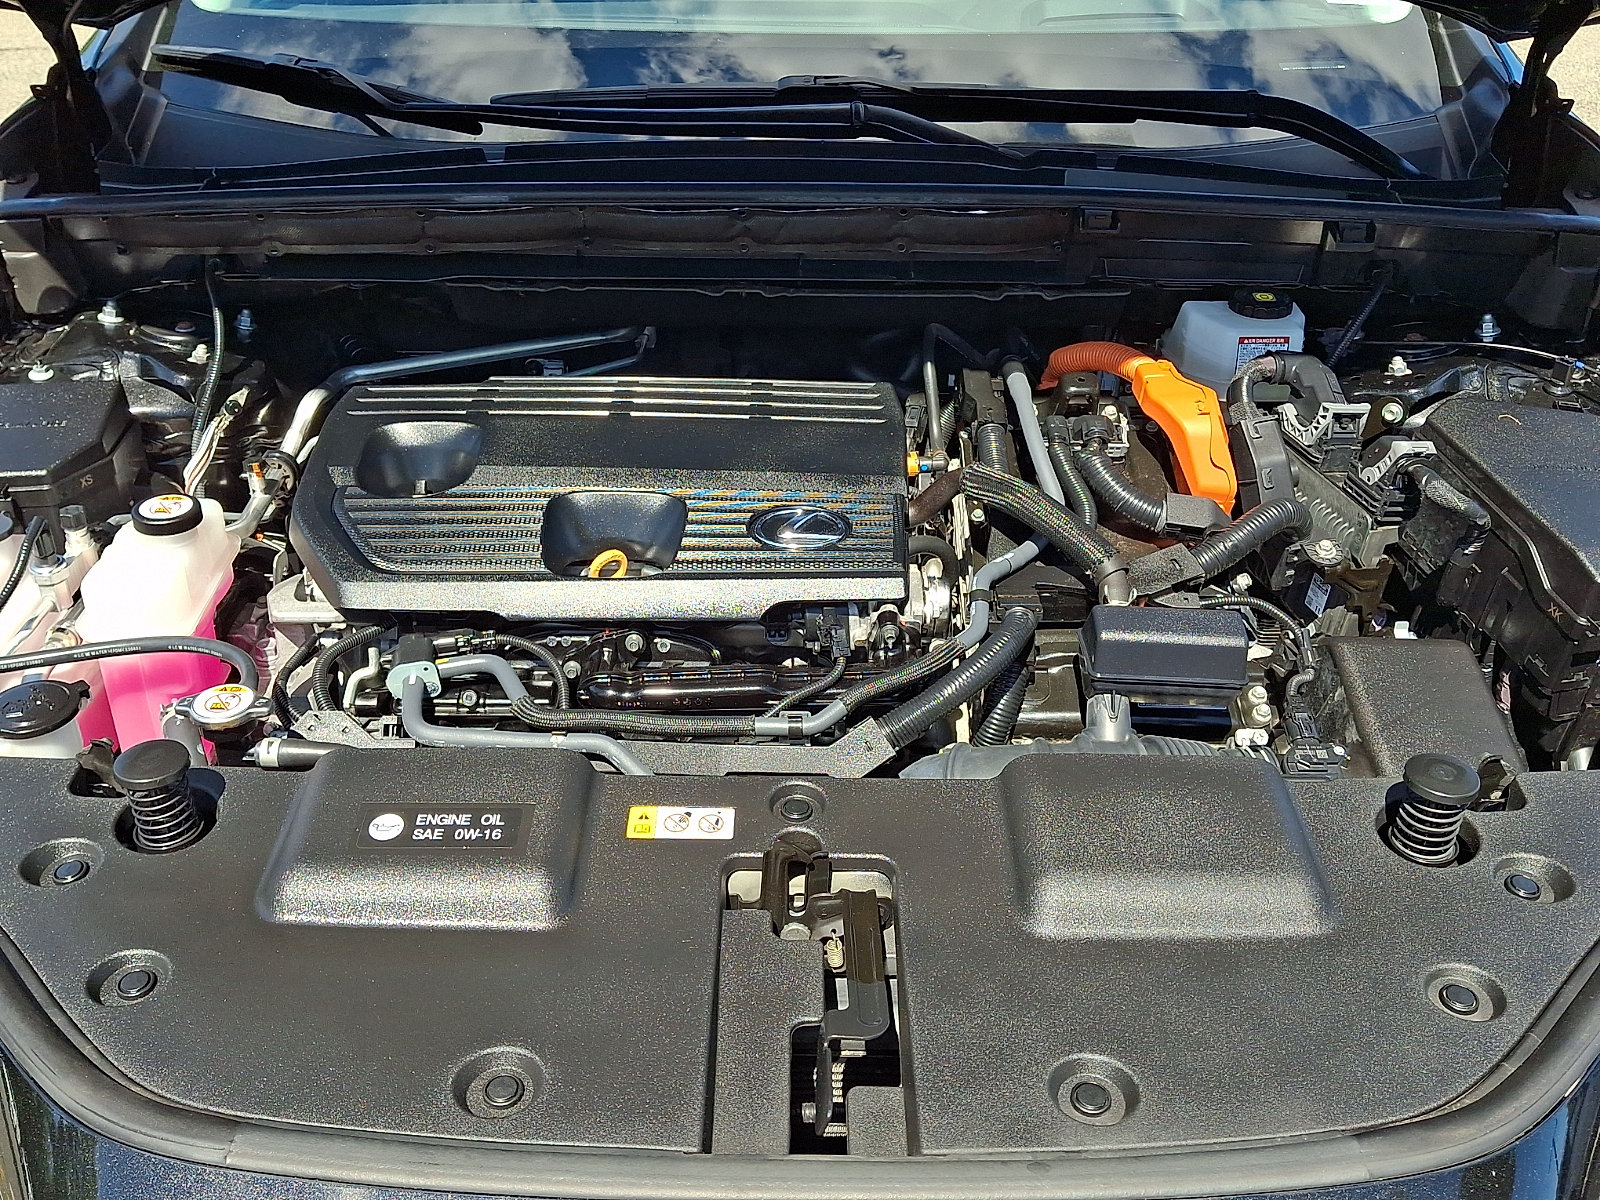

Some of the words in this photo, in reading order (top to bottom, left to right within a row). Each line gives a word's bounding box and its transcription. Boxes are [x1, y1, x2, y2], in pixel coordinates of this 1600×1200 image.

[79, 474, 93, 488] XS
[415, 813, 472, 826] ENGINE
[480, 813, 505, 826] OIL
[412, 828, 444, 840] SAE
[454, 828, 503, 840] 0W-16
